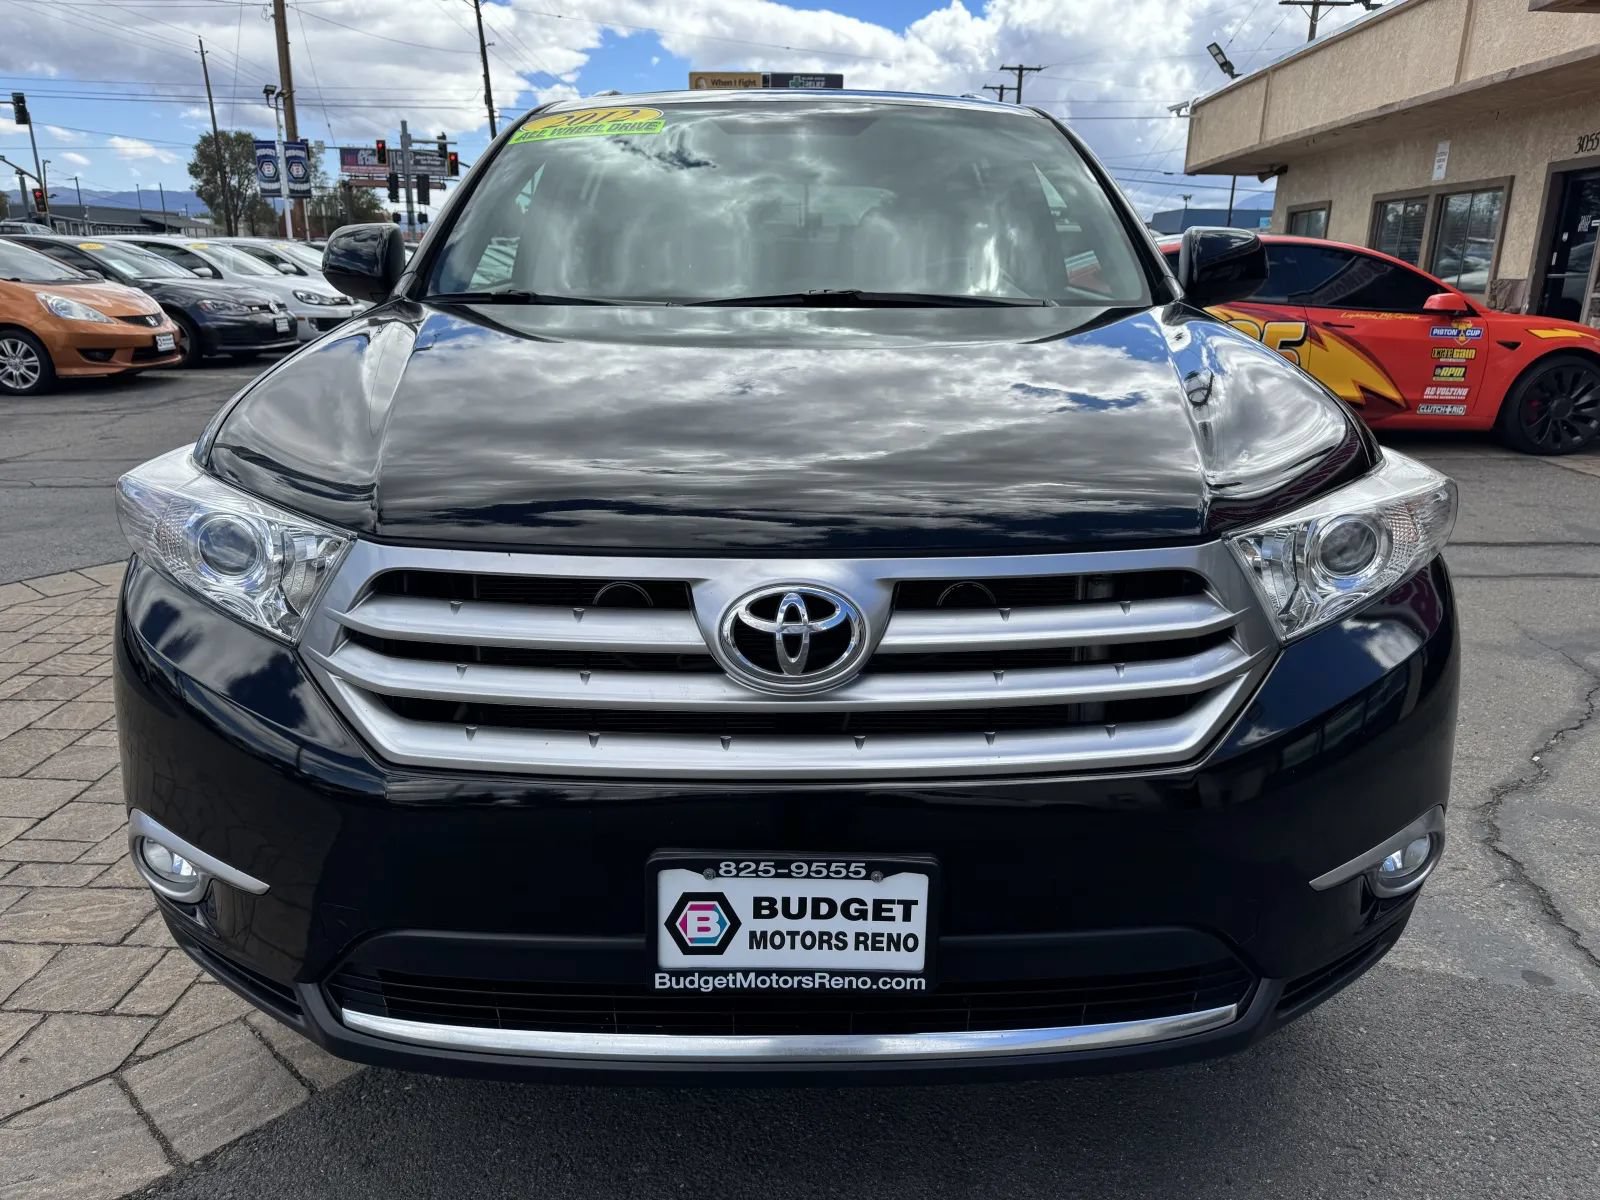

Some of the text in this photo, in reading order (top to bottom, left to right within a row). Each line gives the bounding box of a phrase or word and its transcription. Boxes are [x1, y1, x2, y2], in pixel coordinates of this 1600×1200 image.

[514, 120, 660, 142] ALL WHEEL DRIVE
[1574, 133, 1600, 154] 3055
[1433, 328, 1458, 336] PISTON
[718, 861, 867, 879] 825-9555
[752, 896, 919, 923] BUDGET
[748, 930, 920, 953] MOTORS RENO
[654, 971, 926, 993] BudgetMotorsReno.com
